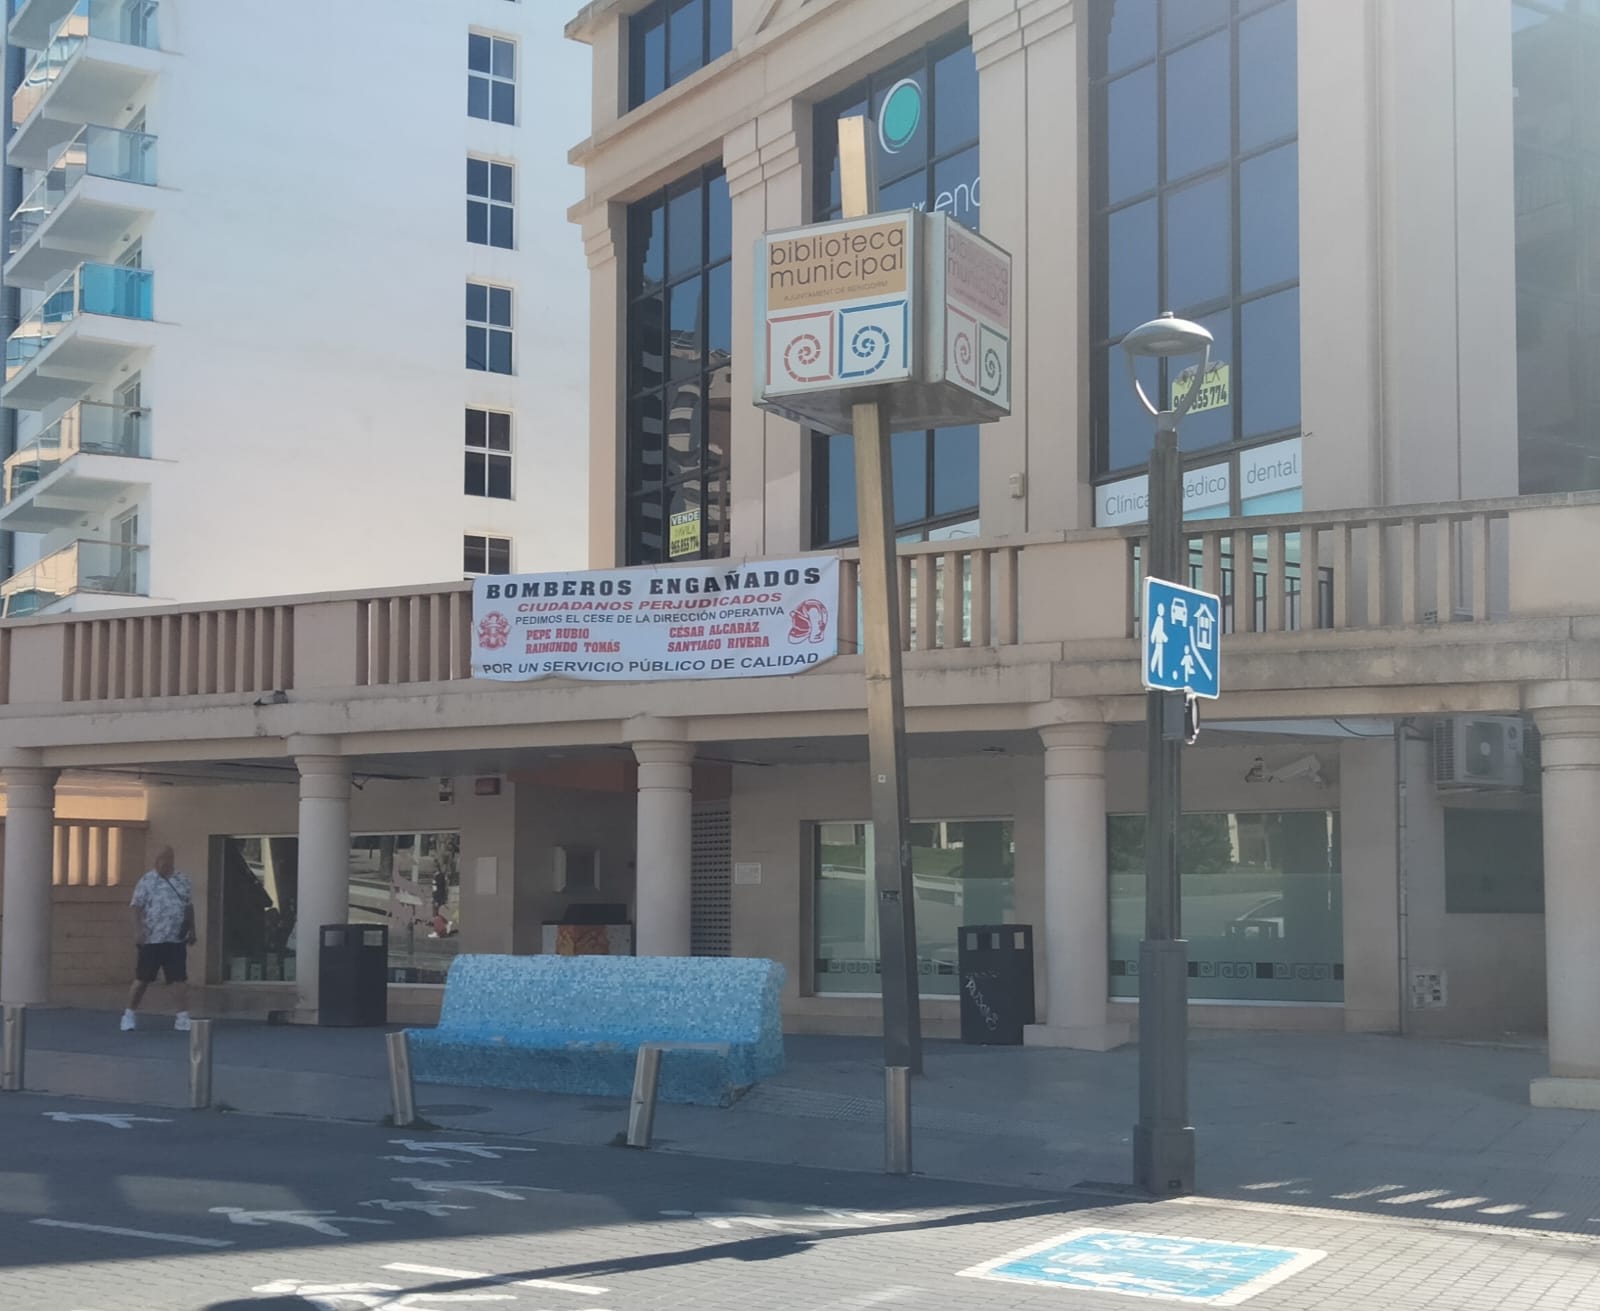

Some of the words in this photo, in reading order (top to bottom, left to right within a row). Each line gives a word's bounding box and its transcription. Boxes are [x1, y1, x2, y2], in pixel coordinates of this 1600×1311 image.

[770, 228, 904, 266] biblioteca
[770, 246, 903, 289] municipal
[1246, 452, 1298, 485] dental
[1105, 493, 1150, 516] Clínica
[671, 511, 700, 525] VENDE
[486, 580, 632, 600] BOMBEROS
[649, 567, 821, 595] ENGAÑADOS
[517, 600, 633, 613] CIUDADANOS
[638, 592, 782, 611] PERJUDICADOS
[515, 614, 563, 625] PEDIMOS
[566, 614, 580, 624] EL
[583, 613, 613, 624] CESE
[616, 614, 633, 624] DE
[635, 613, 650, 624] LA
[653, 609, 716, 623] DIRECCIÓN
[719, 606, 785, 620] OPERATIVA
[526, 629, 552, 641] PEPE
[555, 628, 590, 640] RUBIO
[708, 621, 760, 637] ALCARAZ
[667, 638, 722, 653] SANTIAGO
[726, 636, 770, 650] RIVERA
[482, 663, 513, 674] POR
[518, 663, 538, 673] UN
[542, 661, 624, 673] SERVICIO
[629, 658, 706, 673] PÚBLICO
[710, 657, 736, 671] DE
[740, 652, 819, 669] CALIDAD
